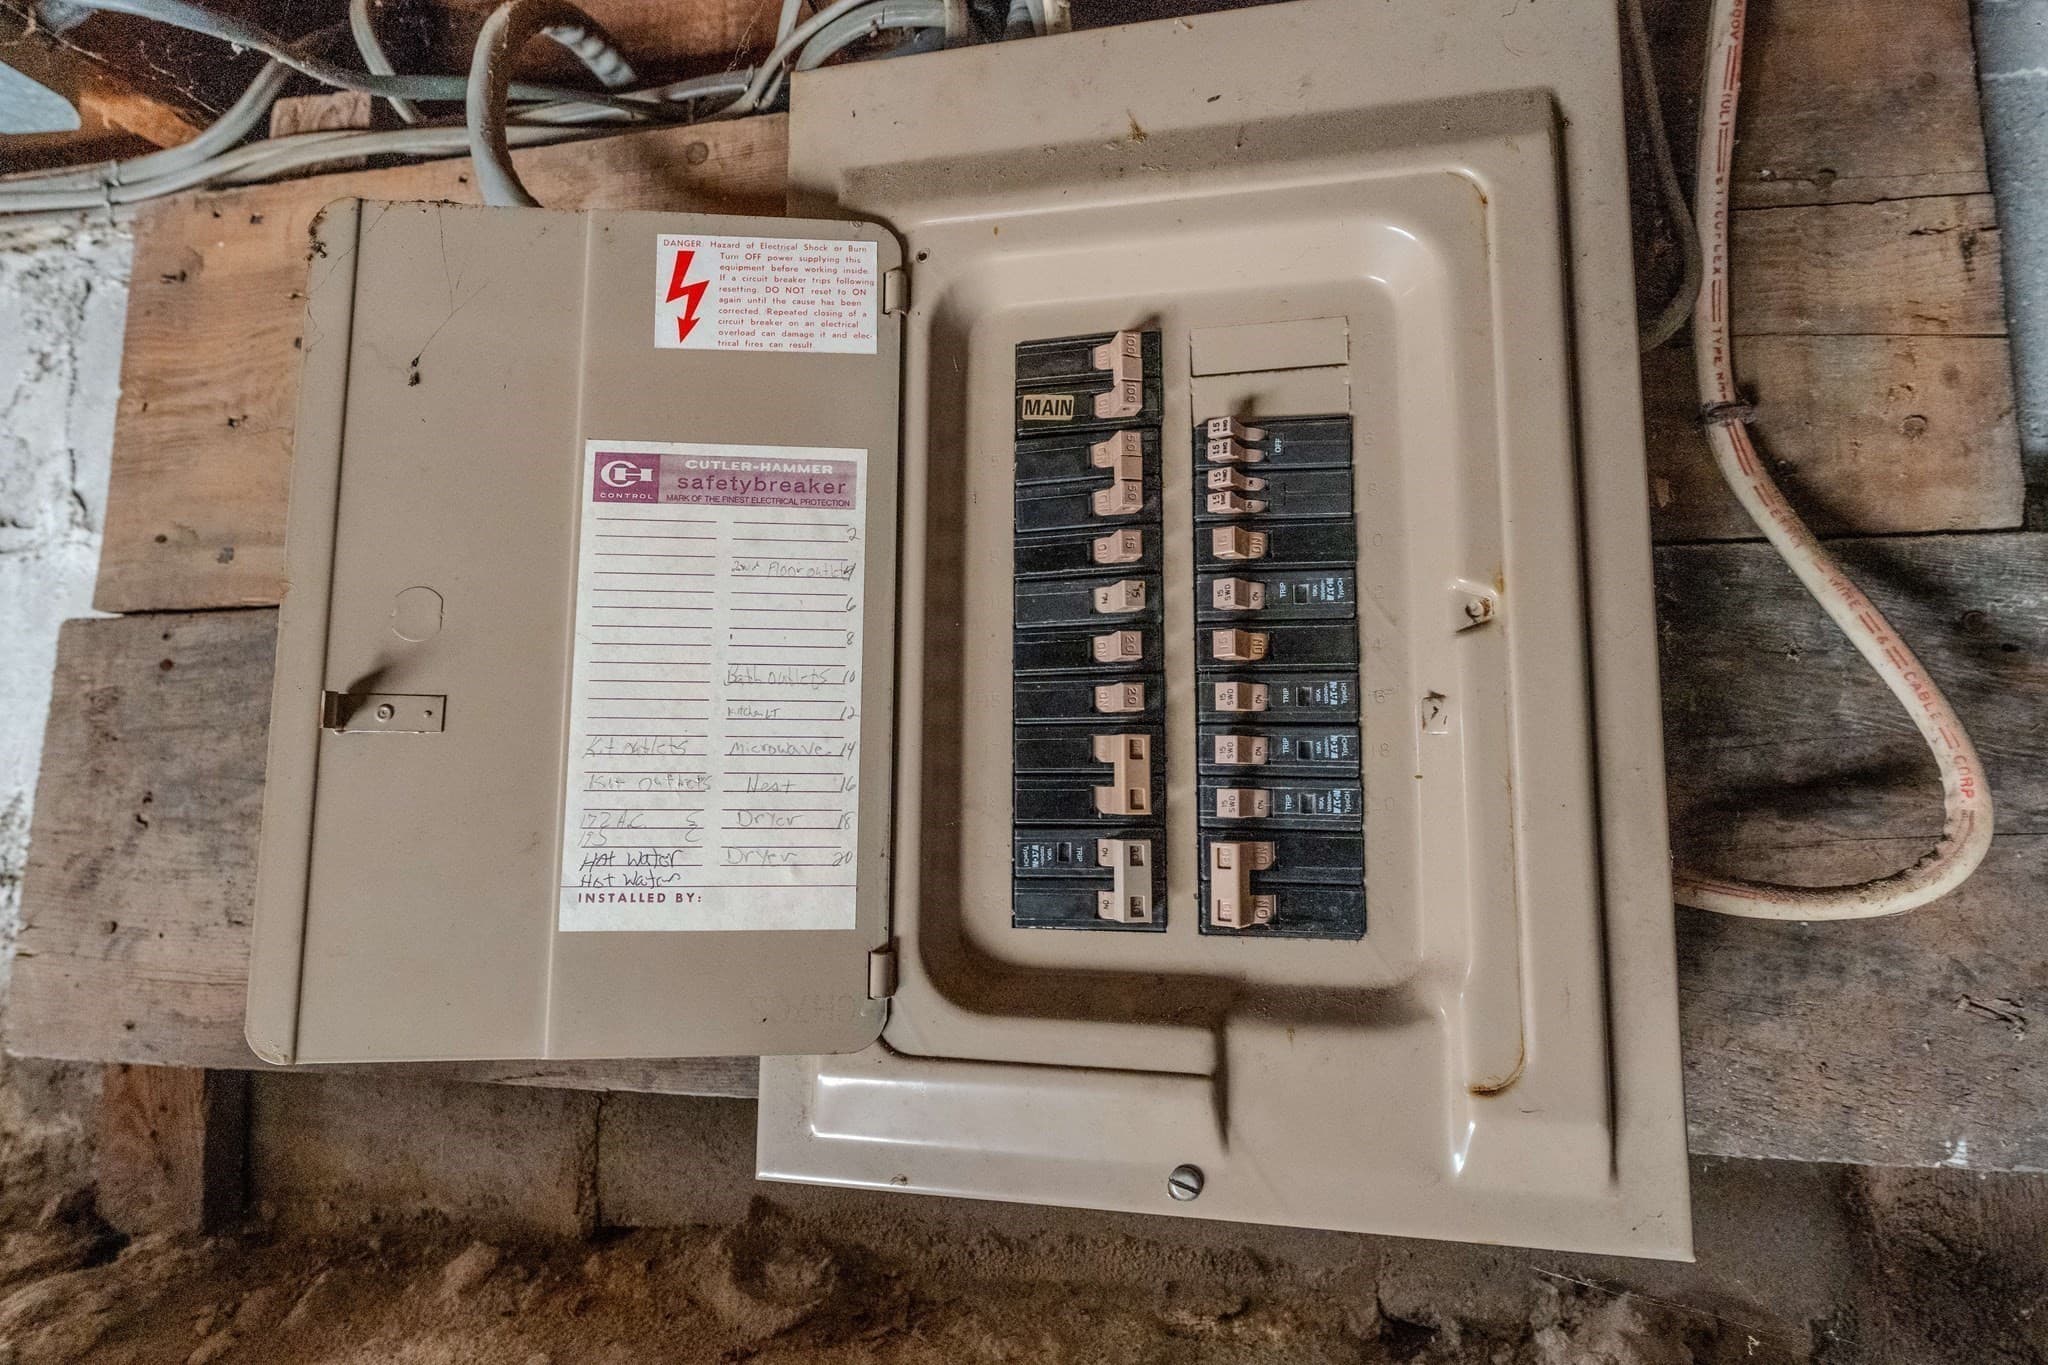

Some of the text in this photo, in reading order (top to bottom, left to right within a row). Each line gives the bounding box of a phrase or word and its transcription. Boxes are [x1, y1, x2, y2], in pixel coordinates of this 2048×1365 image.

[710, 240, 740, 248] Hazard
[760, 242, 798, 250] Electrical
[804, 243, 828, 251] Shock
[848, 244, 867, 252] Burn
[720, 252, 739, 260] Turn
[744, 252, 762, 260] OFF
[800, 255, 840, 264] supplying
[771, 264, 798, 272] before
[804, 266, 838, 274] working
[774, 275, 806, 284] breaker
[812, 277, 831, 285] trips
[836, 278, 874, 286] following
[852, 288, 866, 296] ON
[718, 296, 742, 304] again
[766, 308, 808, 316] Repeated
[814, 309, 842, 318] closing
[750, 318, 783, 326] breaker
[820, 320, 858, 328] electrical
[718, 328, 756, 336] overload
[781, 330, 814, 338] damage
[745, 340, 764, 348] fires
[1126, 334, 1137, 354] 100
[1712, 327, 1722, 367] TYPE
[1126, 383, 1137, 404] 100
[1024, 398, 1072, 416] MAIN
[1212, 422, 1220, 433] 15
[1212, 444, 1220, 456] 15
[1274, 438, 1282, 453] OFF
[685, 460, 833, 474] CUTLER-HAMMER
[1214, 472, 1222, 482] 15
[677, 474, 846, 495] safetybreaker
[600, 492, 654, 500] CONTROL
[705, 495, 720, 503] THE
[722, 496, 749, 504] FINEST
[751, 496, 799, 506] ELECTRICAL
[800, 498, 850, 507] PROTECTION
[1212, 494, 1220, 506] 15
[847, 528, 859, 542] 2
[1126, 536, 1136, 549] 15
[846, 596, 857, 612] 6
[846, 631, 855, 646] 8
[842, 670, 856, 685] 10
[1128, 688, 1138, 705] 20
[1903, 670, 1943, 721] CABLE
[840, 706, 860, 720] 12
[840, 740, 856, 760] 14
[840, 775, 857, 793] 16
[838, 810, 856, 830] 18
[832, 850, 854, 867] 20
[1076, 846, 1084, 862] TRIP
[581, 872, 616, 888] Hot
[578, 892, 702, 903] INSTALLED BY:
[1256, 900, 1270, 918] ON
